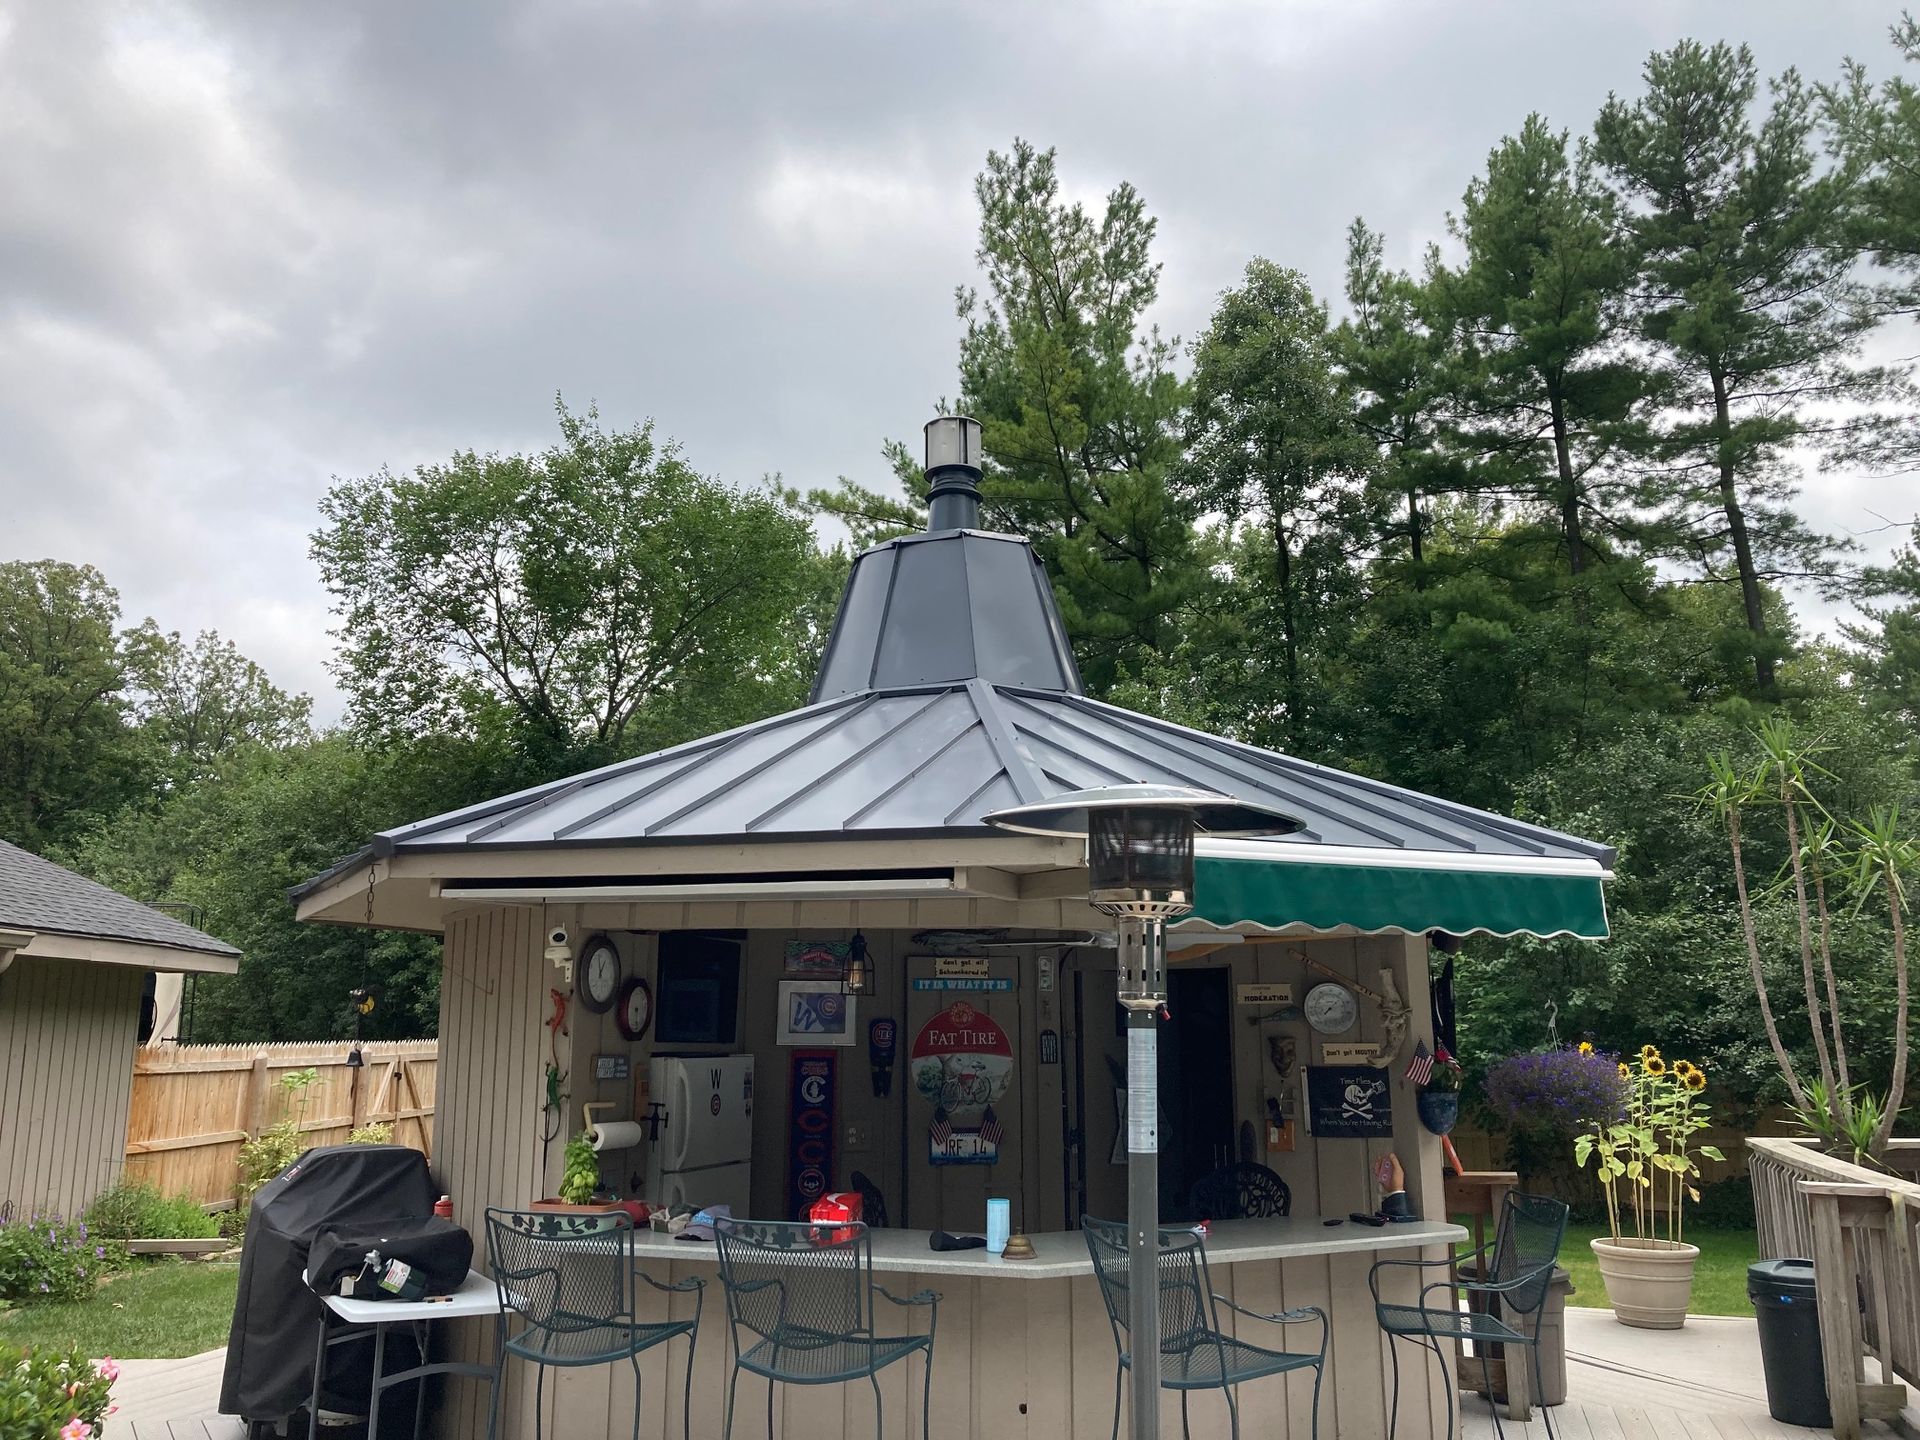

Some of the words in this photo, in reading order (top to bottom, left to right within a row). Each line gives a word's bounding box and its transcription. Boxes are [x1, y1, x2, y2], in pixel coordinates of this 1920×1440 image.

[919, 979, 930, 990] IT
[933, 979, 944, 990] IS
[947, 979, 980, 990] WHAT
[982, 979, 994, 990] IT
[997, 979, 1007, 990] IS
[929, 1030, 957, 1045] FAT
[959, 1029, 997, 1045] TIRE
[710, 1068, 722, 1089] W
[941, 1138, 964, 1156] JRF
[972, 1138, 987, 1156] 14
